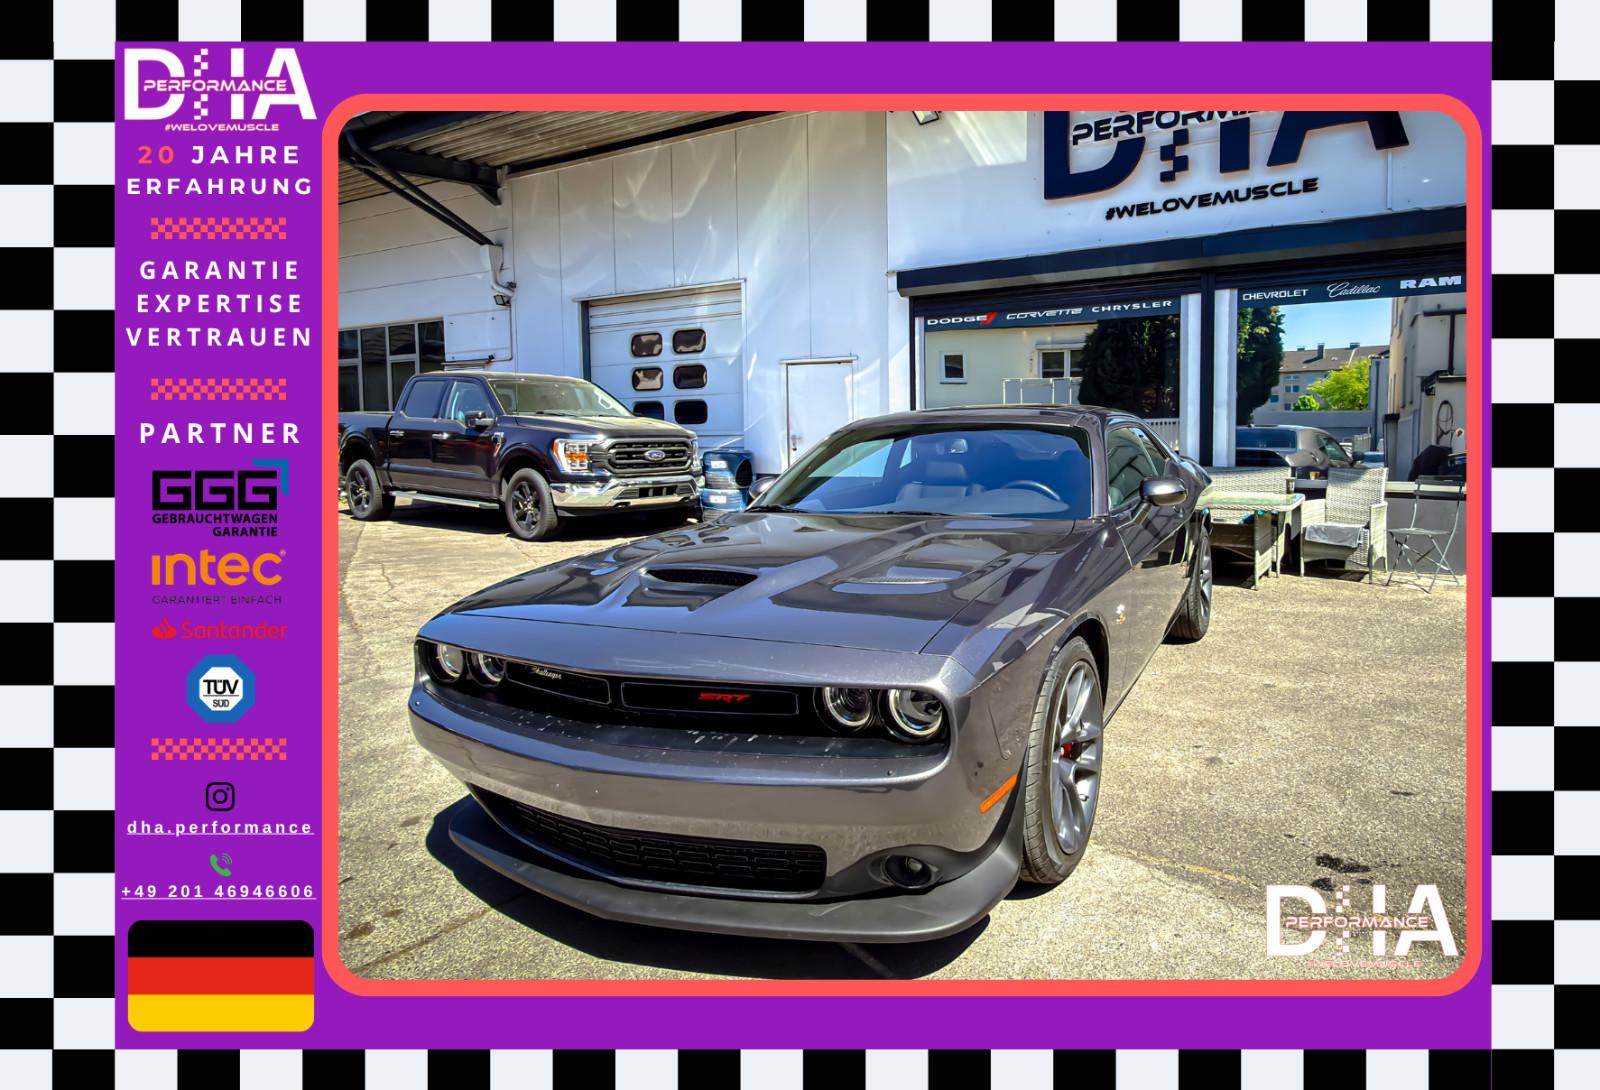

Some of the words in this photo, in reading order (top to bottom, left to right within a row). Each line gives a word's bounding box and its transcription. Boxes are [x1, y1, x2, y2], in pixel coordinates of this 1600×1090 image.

[1072, 111, 1259, 146] PERFOR
[1105, 177, 1319, 221] #WELOVEMUSCLE
[1242, 288, 1309, 301] CHEVROLET
[1326, 281, 1381, 299] Cadillac
[1400, 275, 1462, 290] RAM
[927, 314, 988, 325] DODGE
[1006, 307, 1083, 320] CORVETTE
[1091, 300, 1173, 313] CHRYSLER
